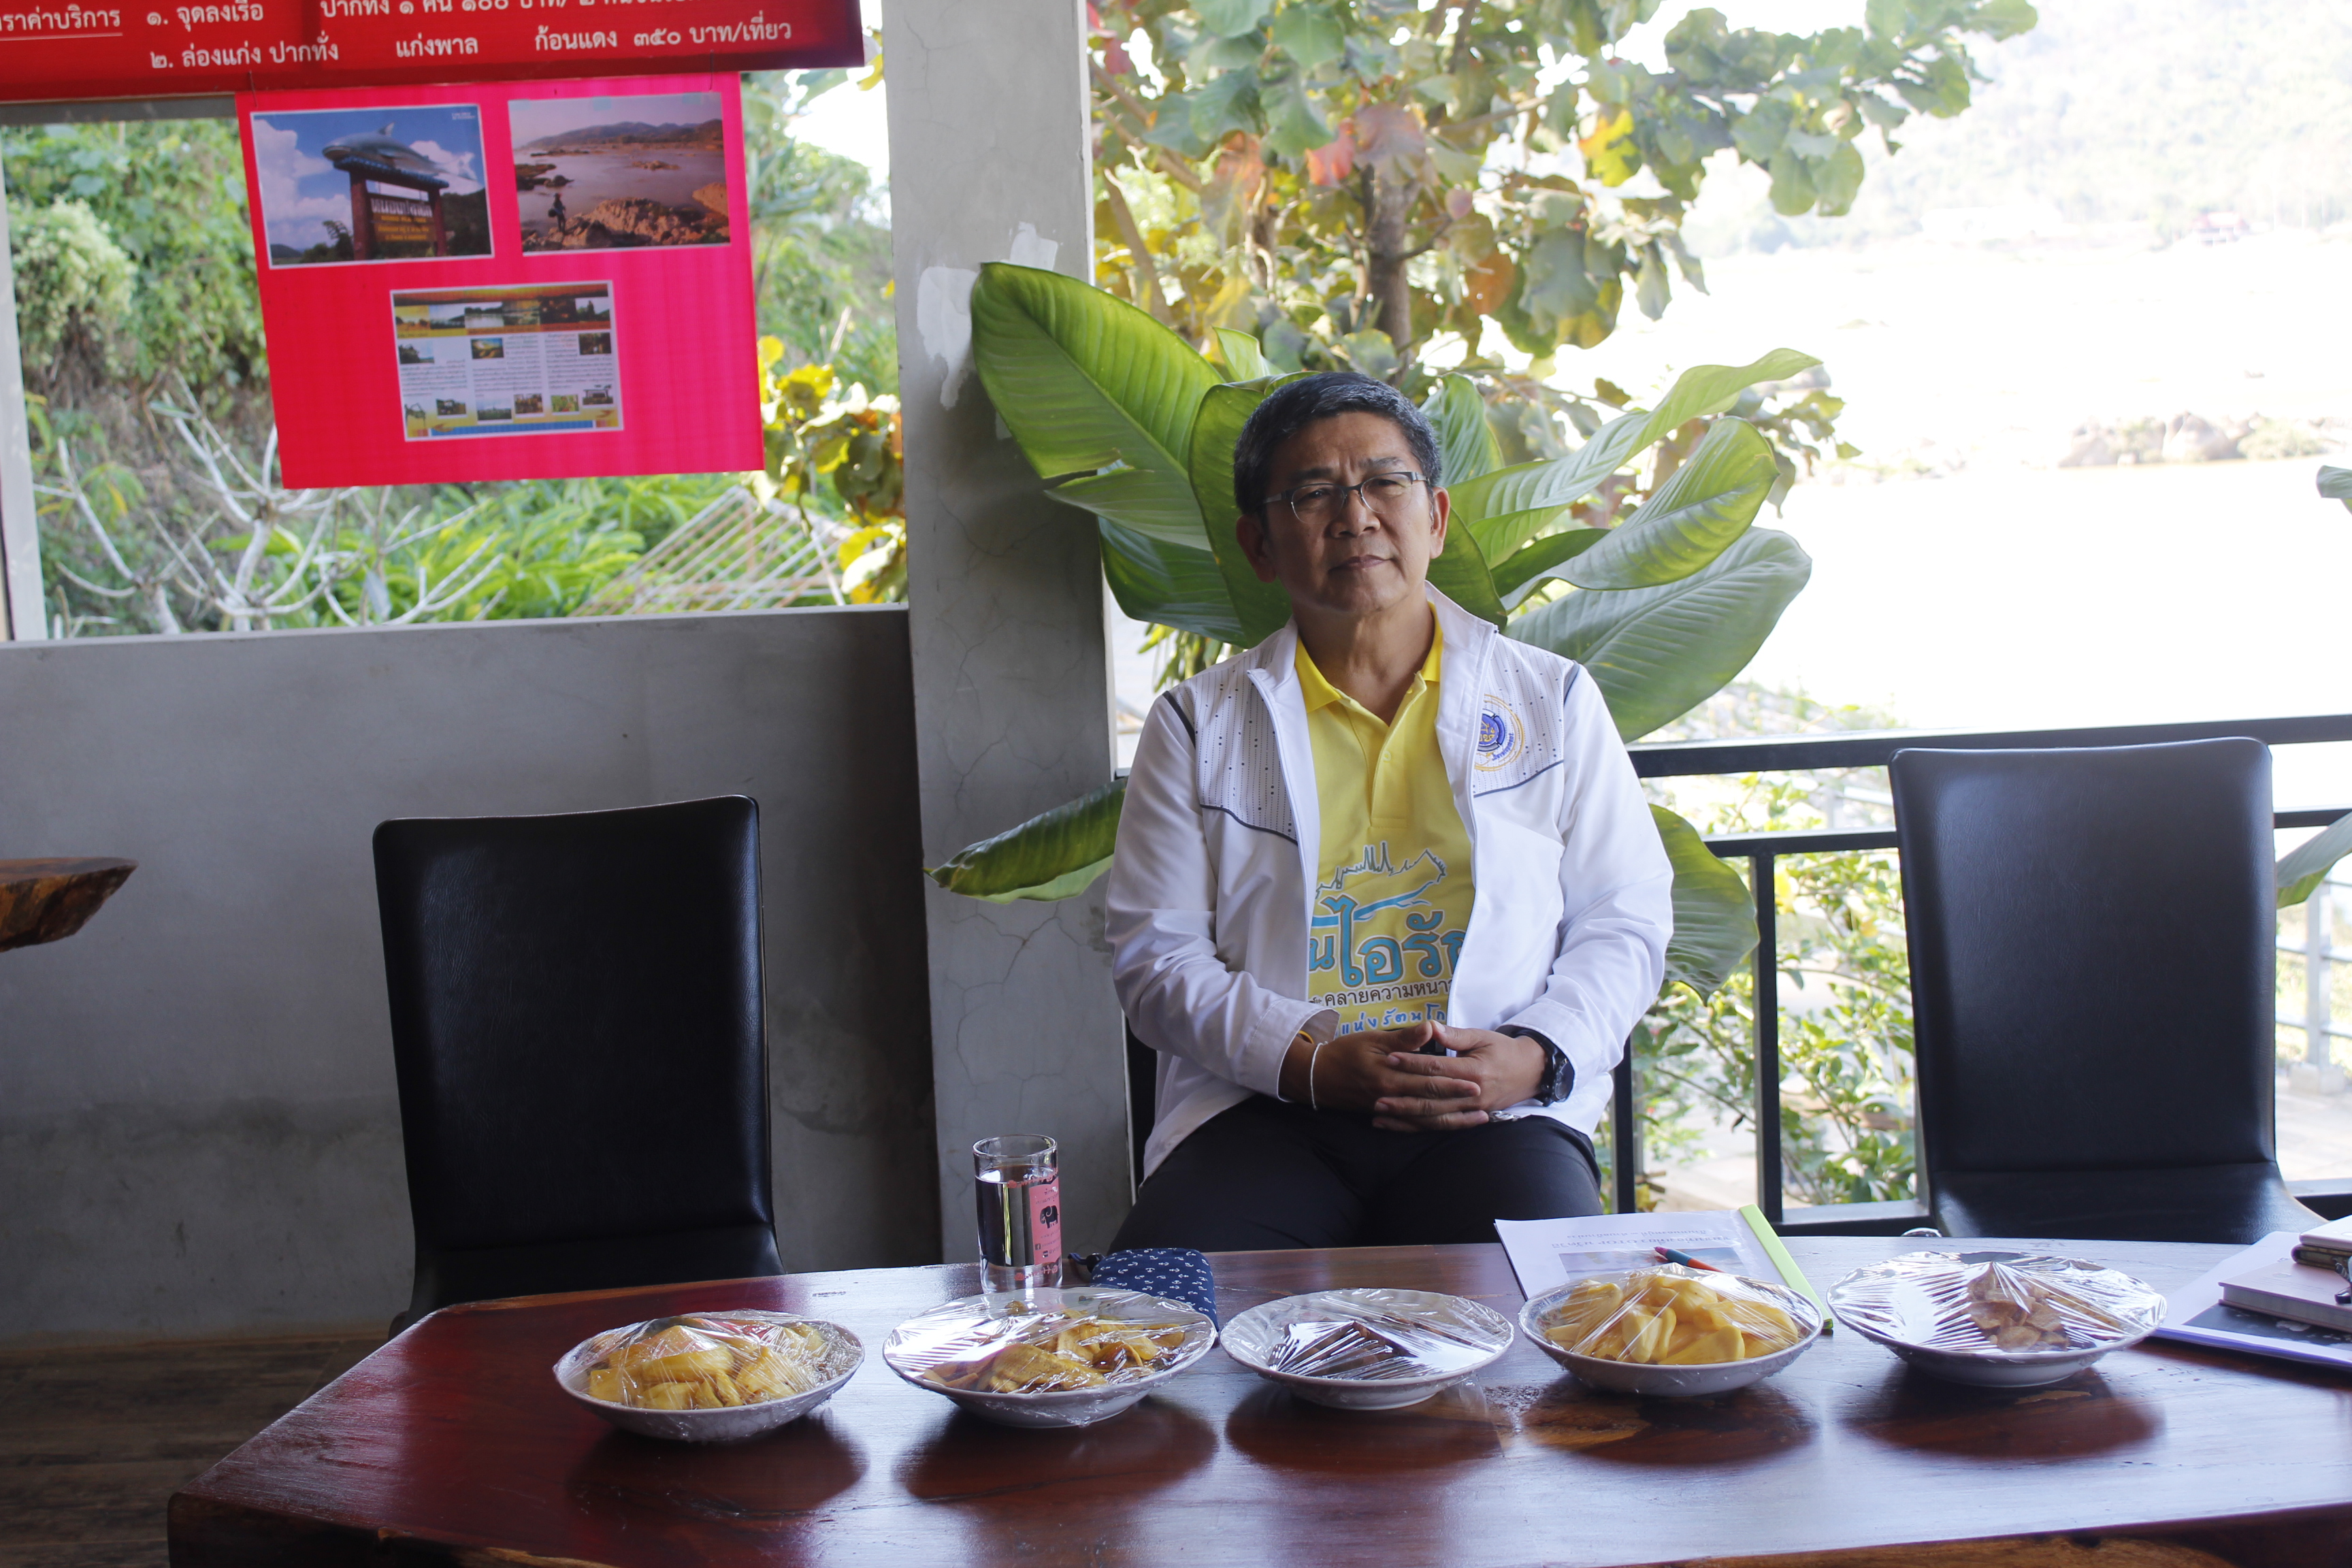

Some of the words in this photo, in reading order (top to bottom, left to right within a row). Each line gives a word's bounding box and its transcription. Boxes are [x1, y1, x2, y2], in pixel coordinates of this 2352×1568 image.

[0, 4, 121, 32] ราค่าบริการ
[182, 40, 262, 67] ล่องแก่ง
[269, 30, 339, 63] ปากทั่ง
[395, 32, 478, 58] แก่งพาล
[535, 24, 617, 51] ก้อนแดง
[689, 10, 792, 44] บาท/เที่ยว
[1324, 978, 1452, 1007] คลายความหนา
[1335, 1003, 1446, 1037] แห่งรัตนโก
